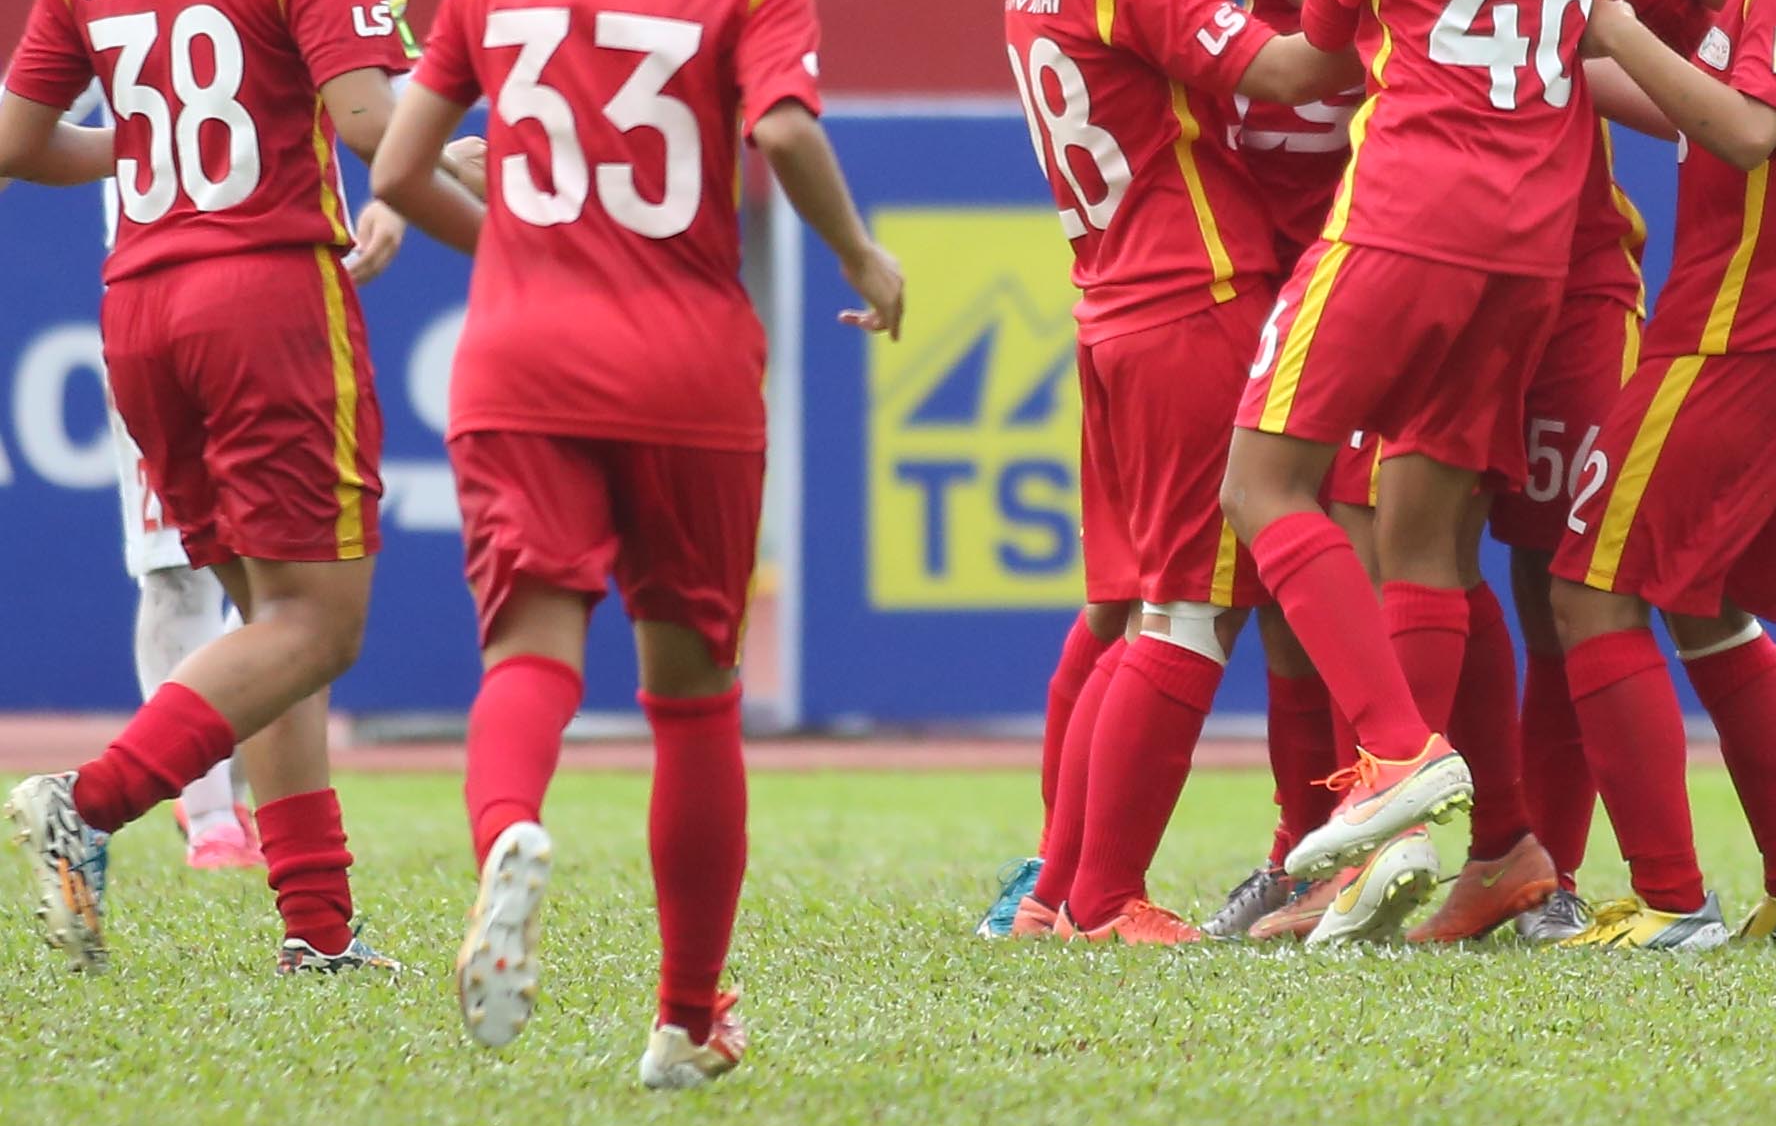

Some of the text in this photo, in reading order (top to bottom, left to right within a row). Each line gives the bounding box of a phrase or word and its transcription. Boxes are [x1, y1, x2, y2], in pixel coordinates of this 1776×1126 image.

[351, 0, 395, 38] LS
[1196, 1, 1248, 57] LS
[86, 2, 261, 225] 38
[482, 5, 704, 241] 33
